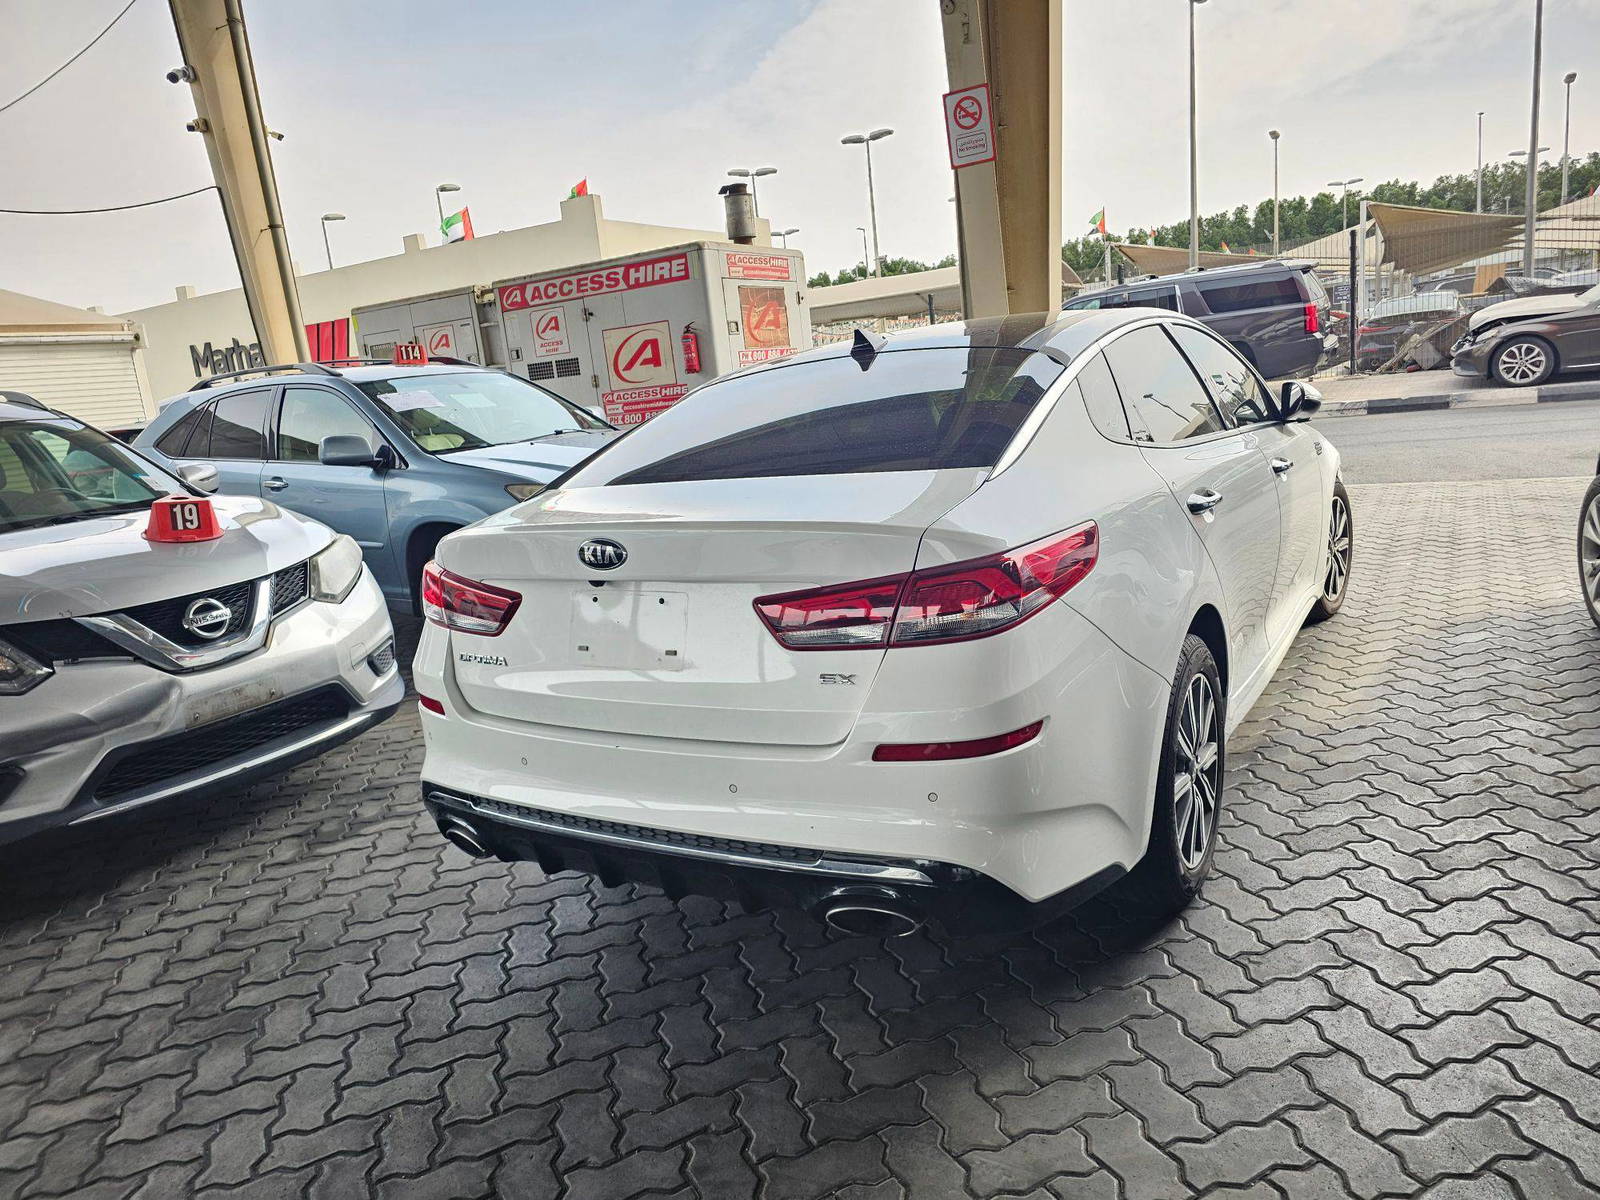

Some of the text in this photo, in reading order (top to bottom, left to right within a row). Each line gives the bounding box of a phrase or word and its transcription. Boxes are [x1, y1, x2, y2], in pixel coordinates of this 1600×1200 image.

[737, 256, 768, 265] ACCESS
[530, 271, 620, 302] ACCESS
[629, 258, 686, 285] HIRE
[540, 340, 564, 348] ACCESS
[401, 345, 421, 360] 114
[616, 389, 658, 401] ACCESS
[661, 386, 688, 397] HIRE
[624, 413, 642, 424] 800
[172, 503, 199, 530] 19
[584, 545, 618, 563] KIA
[190, 608, 231, 626] NISSAN
[819, 673, 856, 685] EX
